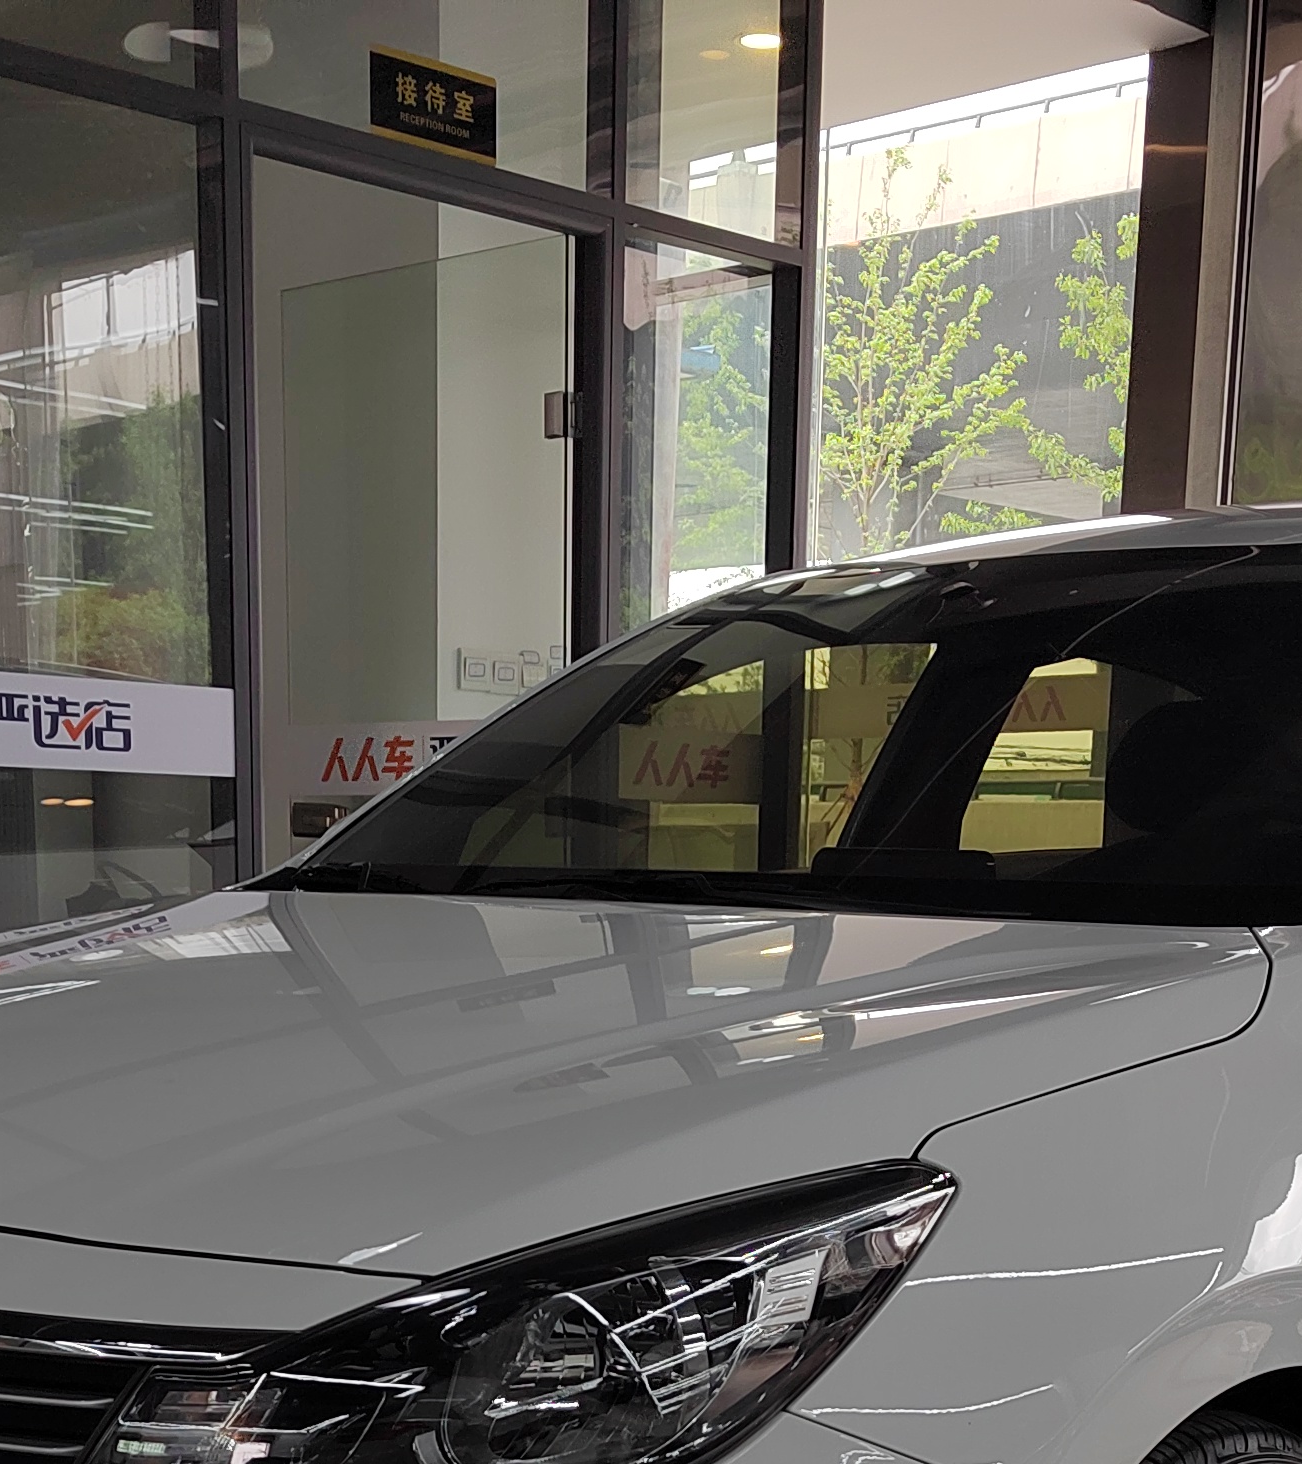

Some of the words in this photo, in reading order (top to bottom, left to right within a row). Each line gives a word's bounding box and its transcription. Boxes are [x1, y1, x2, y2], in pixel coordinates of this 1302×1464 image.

[396, 72, 474, 123] 接待室
[400, 111, 444, 132] RECEPTION
[446, 123, 470, 139] ROOM
[321, 735, 414, 782] 人人车
